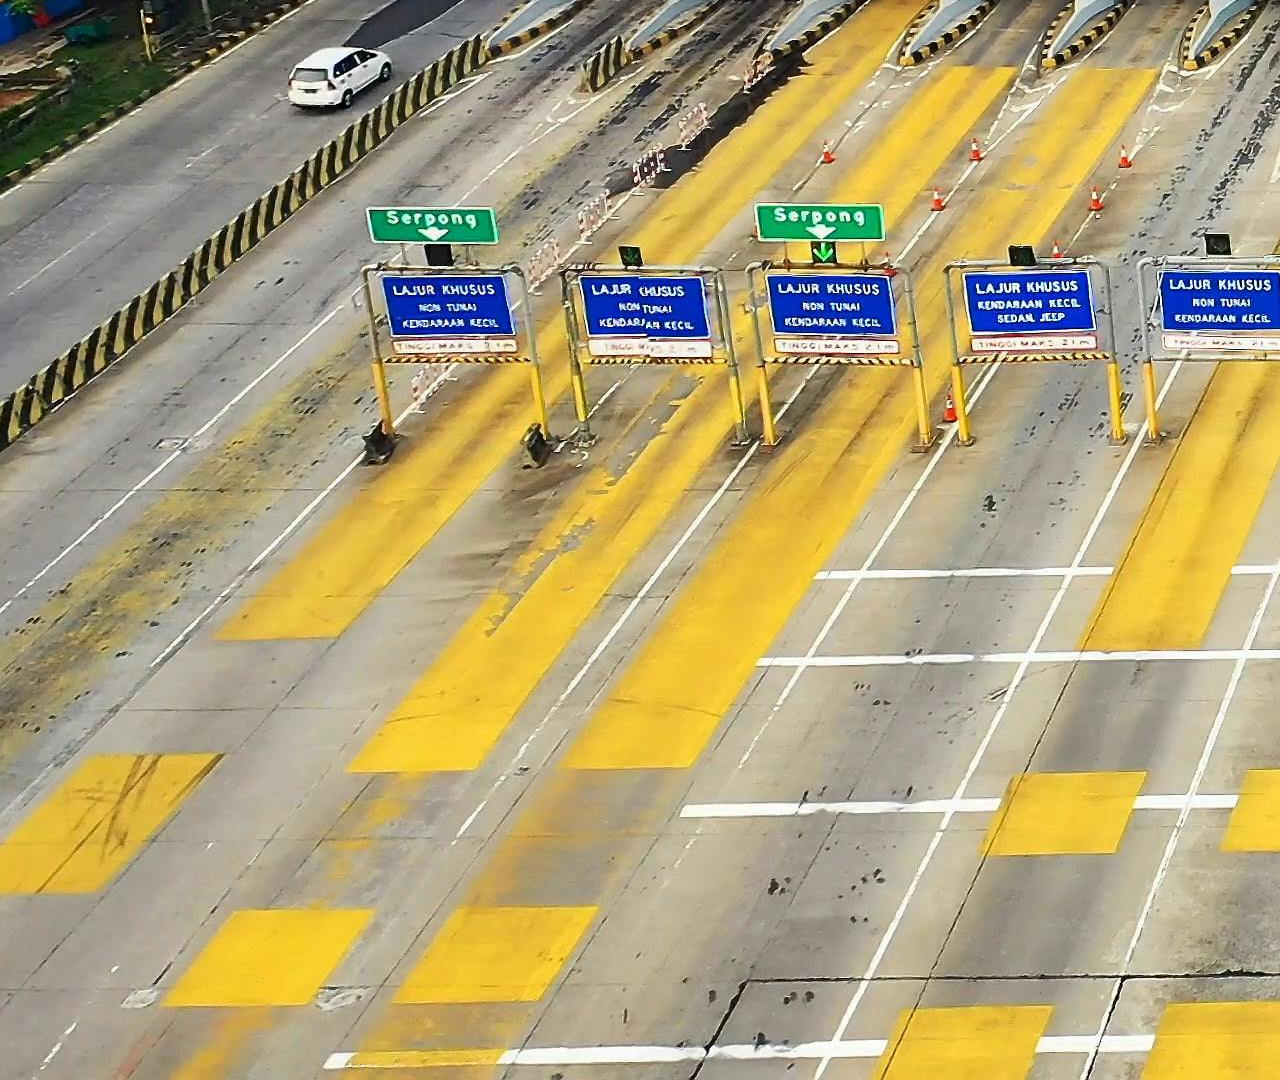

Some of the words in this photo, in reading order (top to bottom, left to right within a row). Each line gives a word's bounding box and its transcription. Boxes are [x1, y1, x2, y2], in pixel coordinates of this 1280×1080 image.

[386, 210, 478, 230] Serpong
[773, 207, 866, 227] Serpong
[393, 284, 435, 296] LAJUR
[442, 284, 496, 295] KHUSUS
[592, 284, 631, 296] LAJUR
[778, 283, 820, 294] LAJUR
[827, 283, 880, 295] KHUSUS
[975, 282, 1021, 294] LAJUR
[1026, 281, 1079, 293] KHUSUS
[1169, 279, 1211, 290] LAJUR
[1218, 279, 1272, 291] KHUSUS
[802, 302, 824, 311] NON
[830, 302, 860, 311] TUNAI
[1192, 298, 1214, 307] NON
[1220, 298, 1251, 307] TUNAI
[1040, 312, 1066, 322] JEEP
[1174, 314, 1236, 323] KENDARAAN
